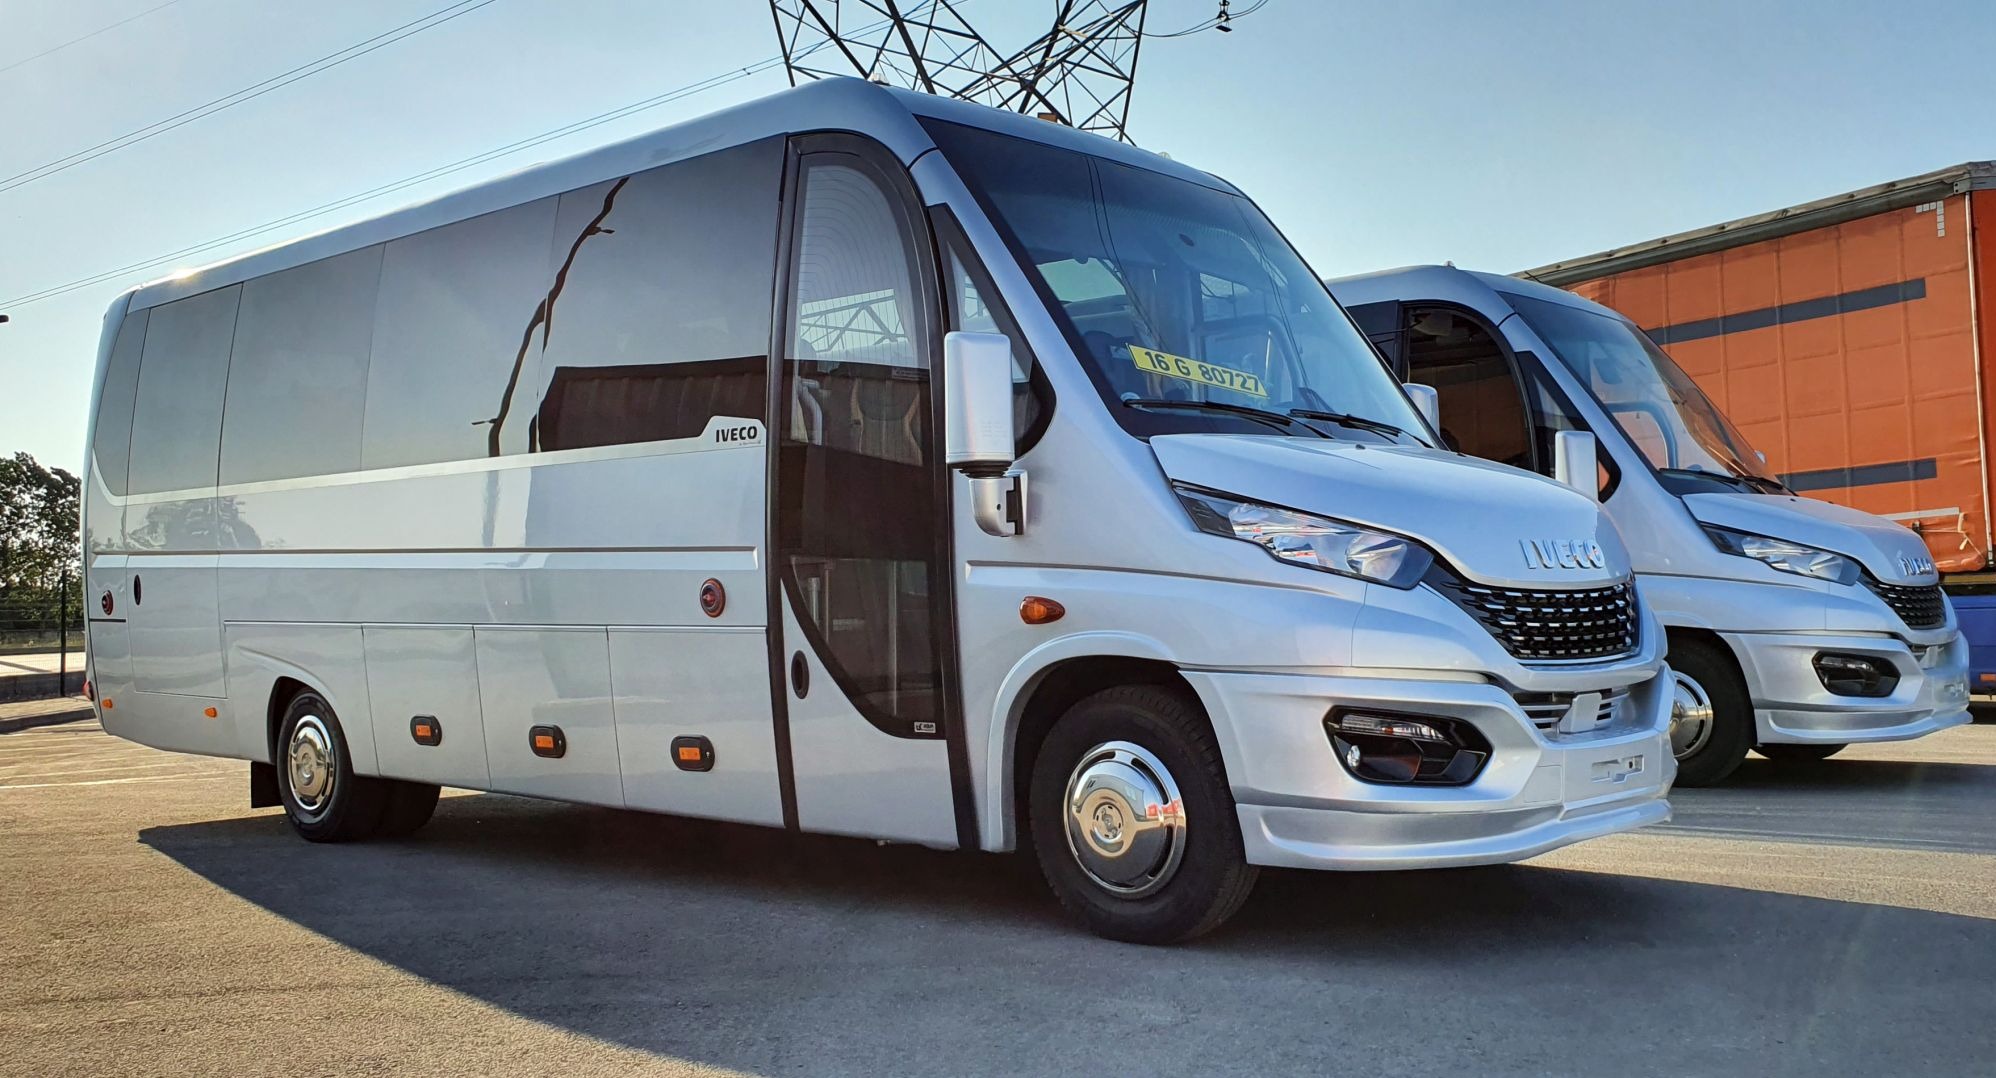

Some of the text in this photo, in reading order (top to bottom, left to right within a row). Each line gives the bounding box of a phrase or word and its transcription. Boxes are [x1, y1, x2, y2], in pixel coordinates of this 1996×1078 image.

[1144, 351, 1259, 392] 16 G 80727
[715, 426, 758, 443] IVECO
[1519, 539, 1605, 569] IVECO
